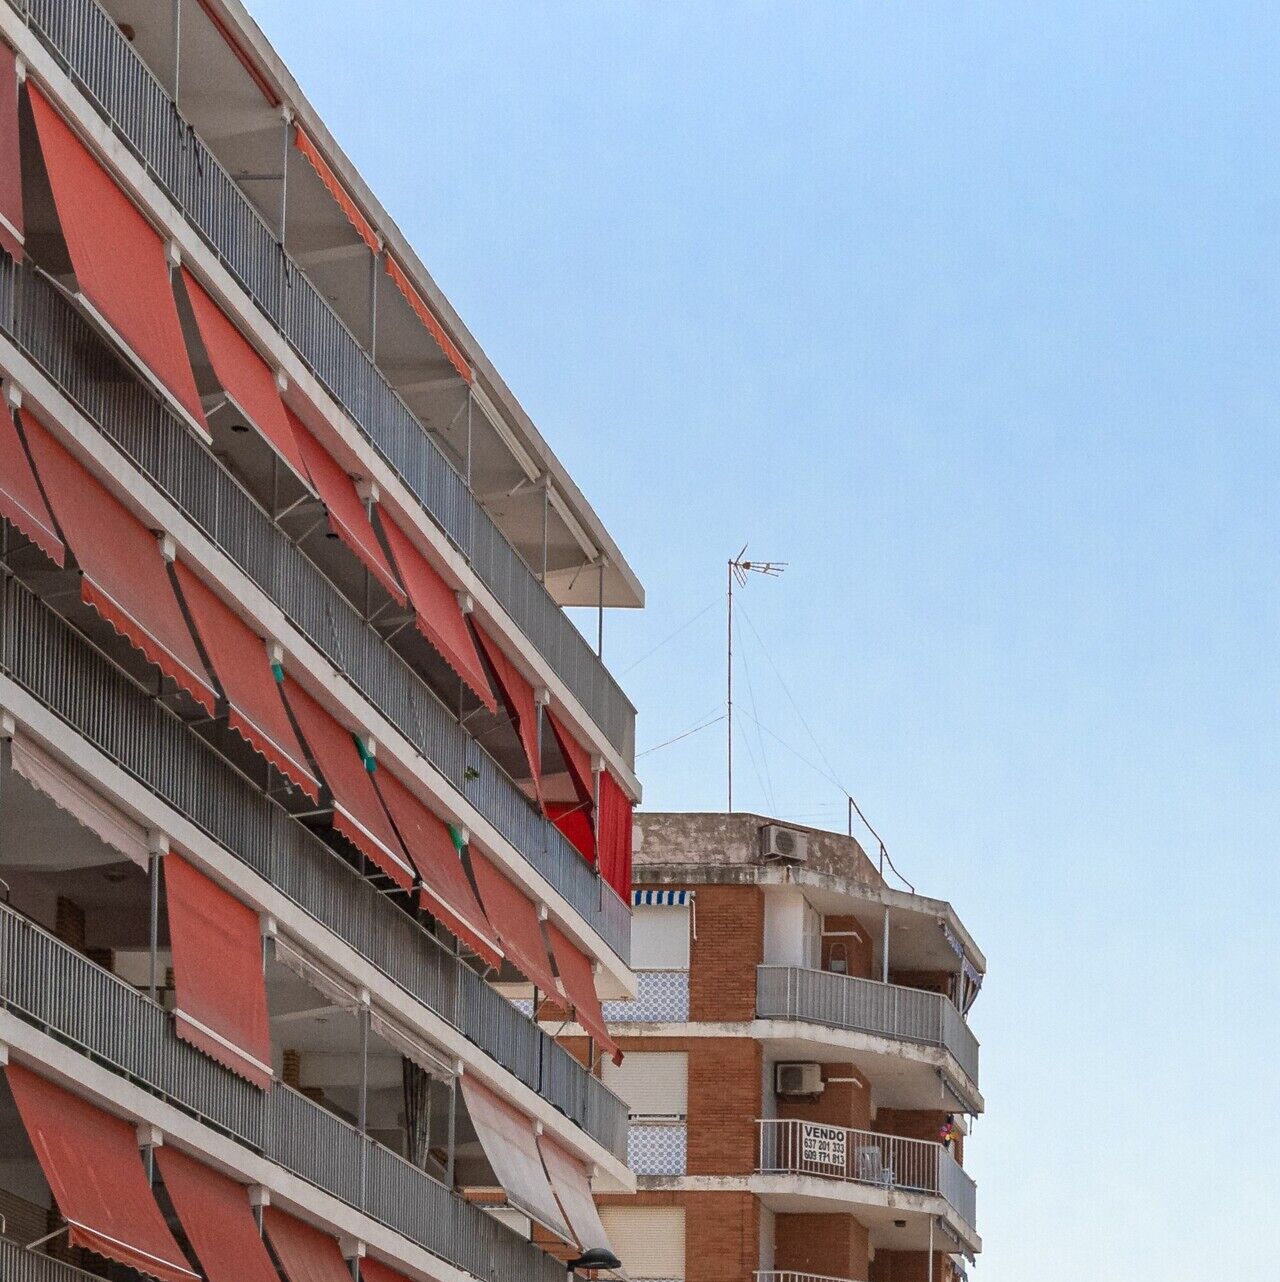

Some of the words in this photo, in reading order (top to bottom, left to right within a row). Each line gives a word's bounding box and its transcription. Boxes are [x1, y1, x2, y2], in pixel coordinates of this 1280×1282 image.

[804, 1126, 844, 1142] VENDO
[804, 1138, 816, 1149] 637
[819, 1140, 830, 1151] 201
[832, 1142, 844, 1153] 333
[832, 1154, 844, 1165] 813
